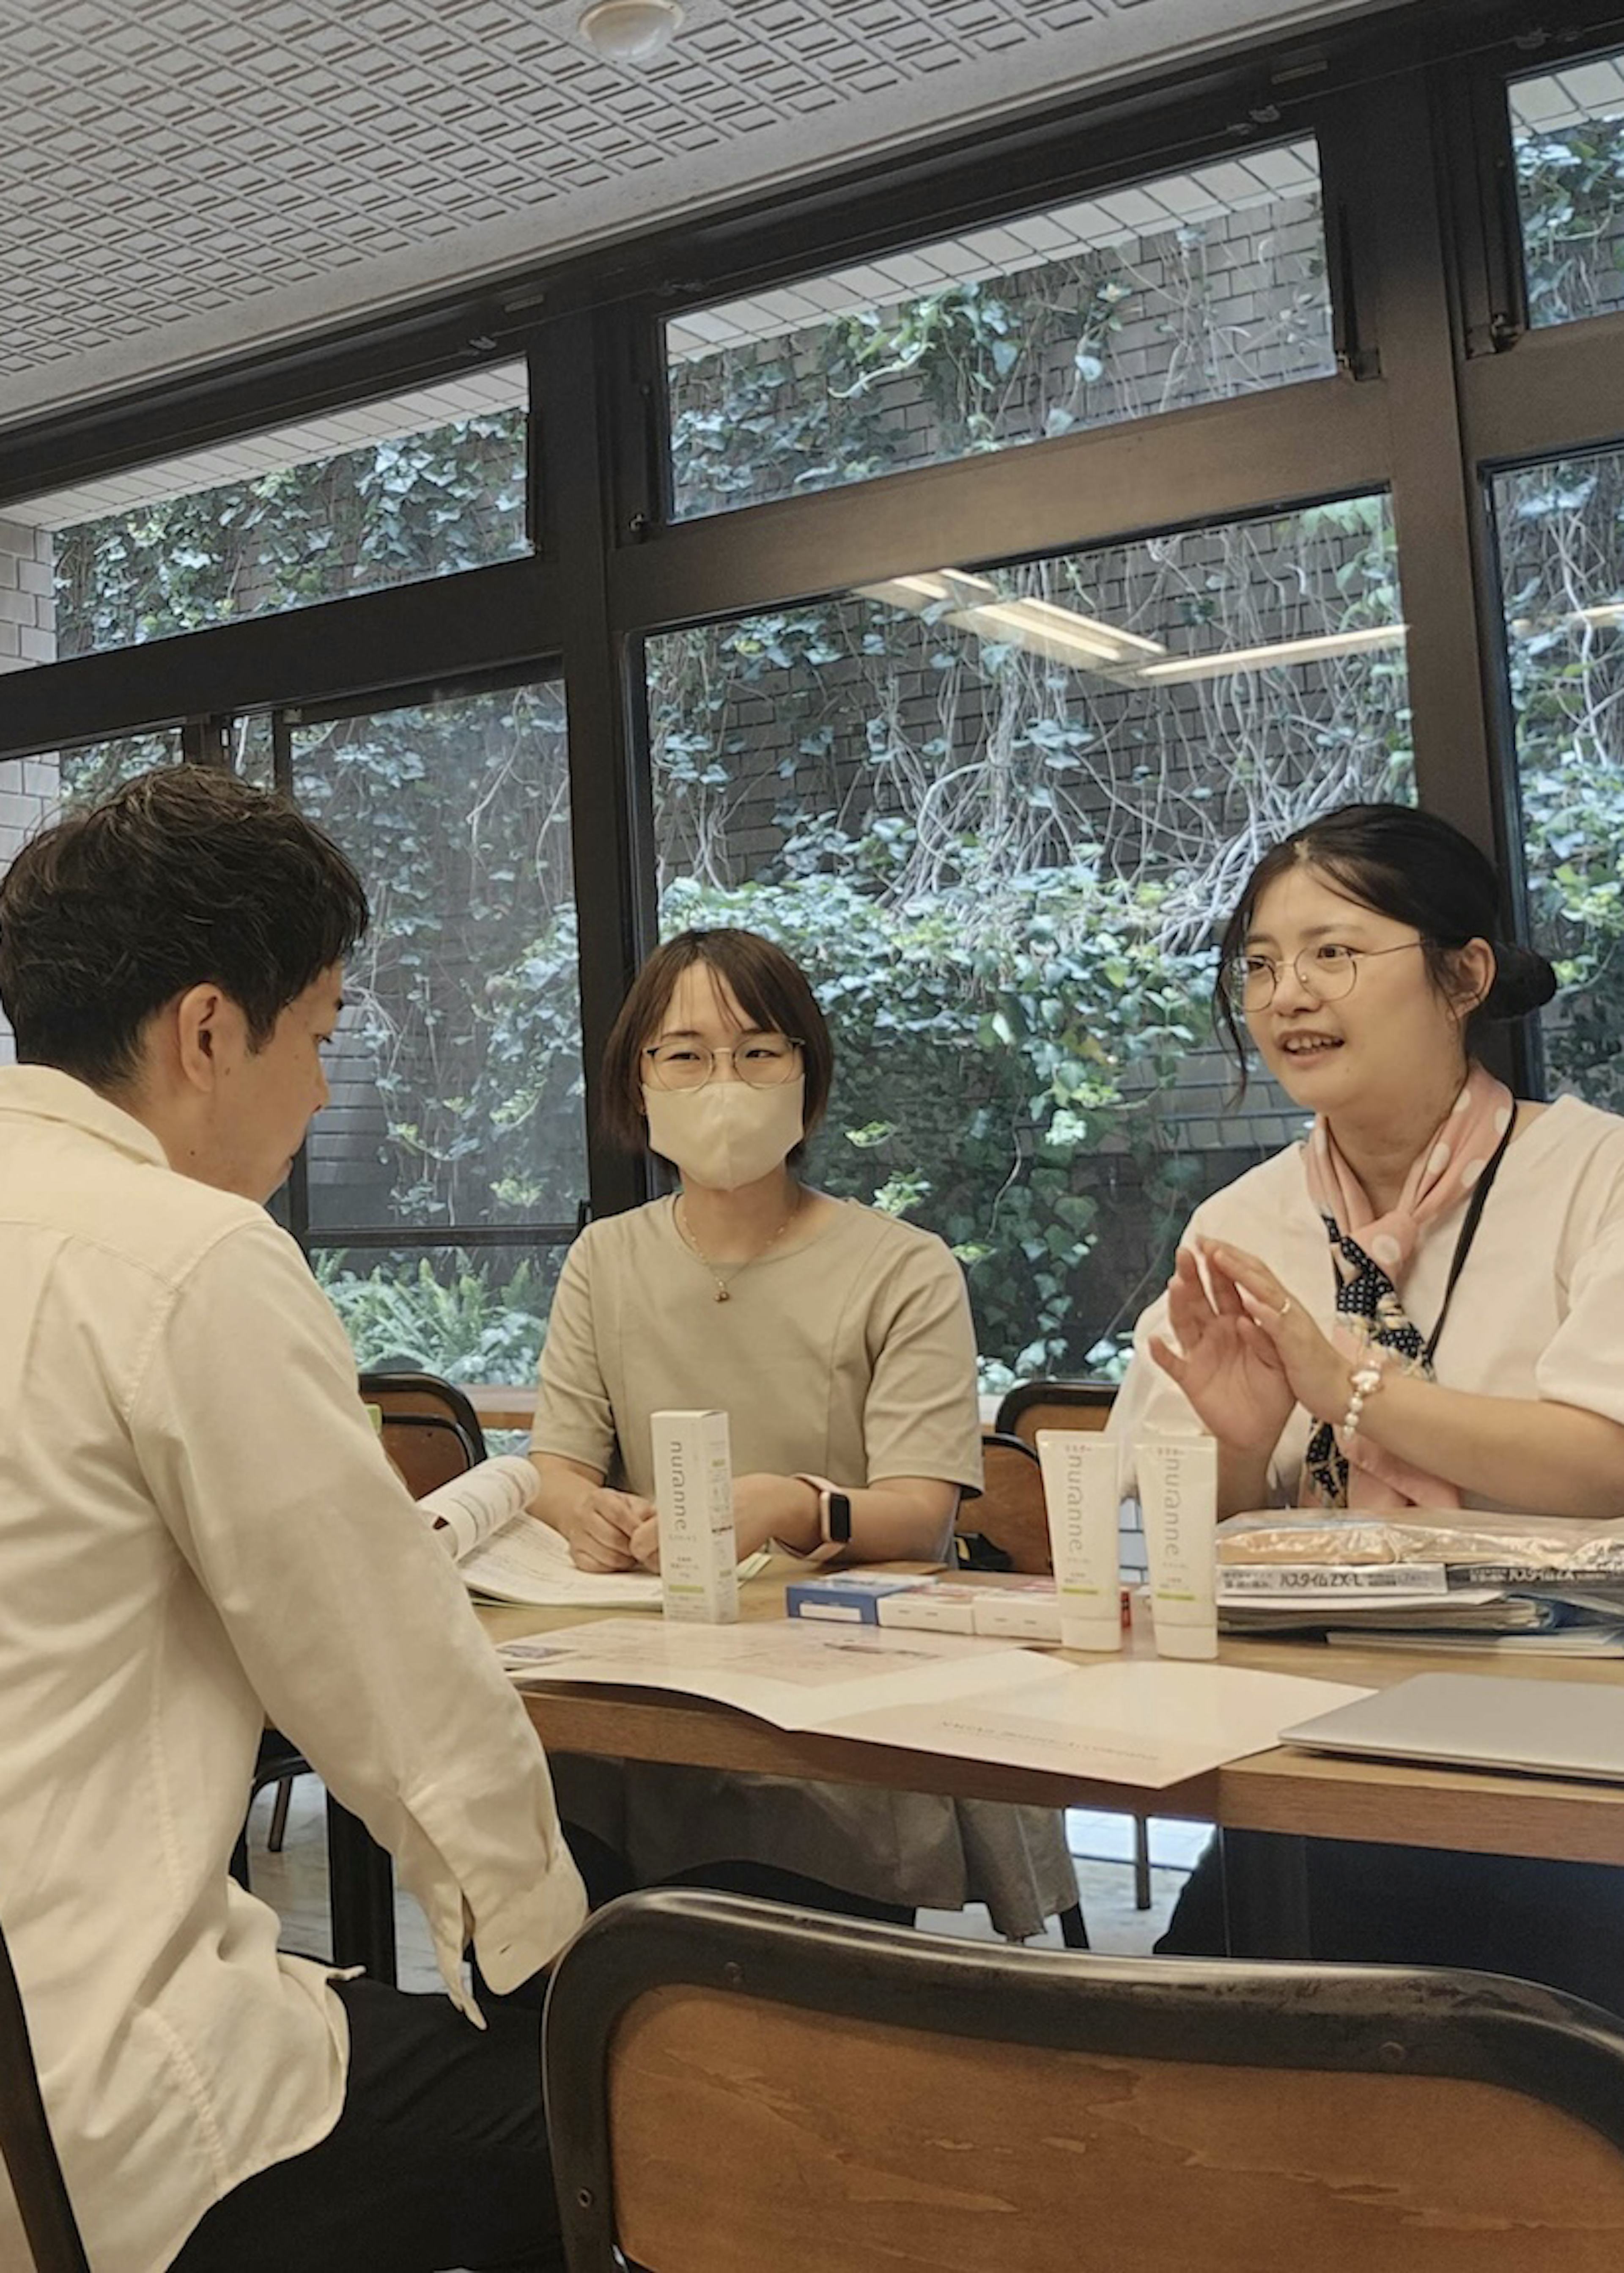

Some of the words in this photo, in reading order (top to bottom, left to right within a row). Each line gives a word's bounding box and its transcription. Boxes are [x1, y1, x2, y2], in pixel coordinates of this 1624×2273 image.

[670, 1441, 687, 1531] nuranne
[1067, 1455, 1083, 1553] nuranne
[1164, 1459, 1181, 1557] nuranne
